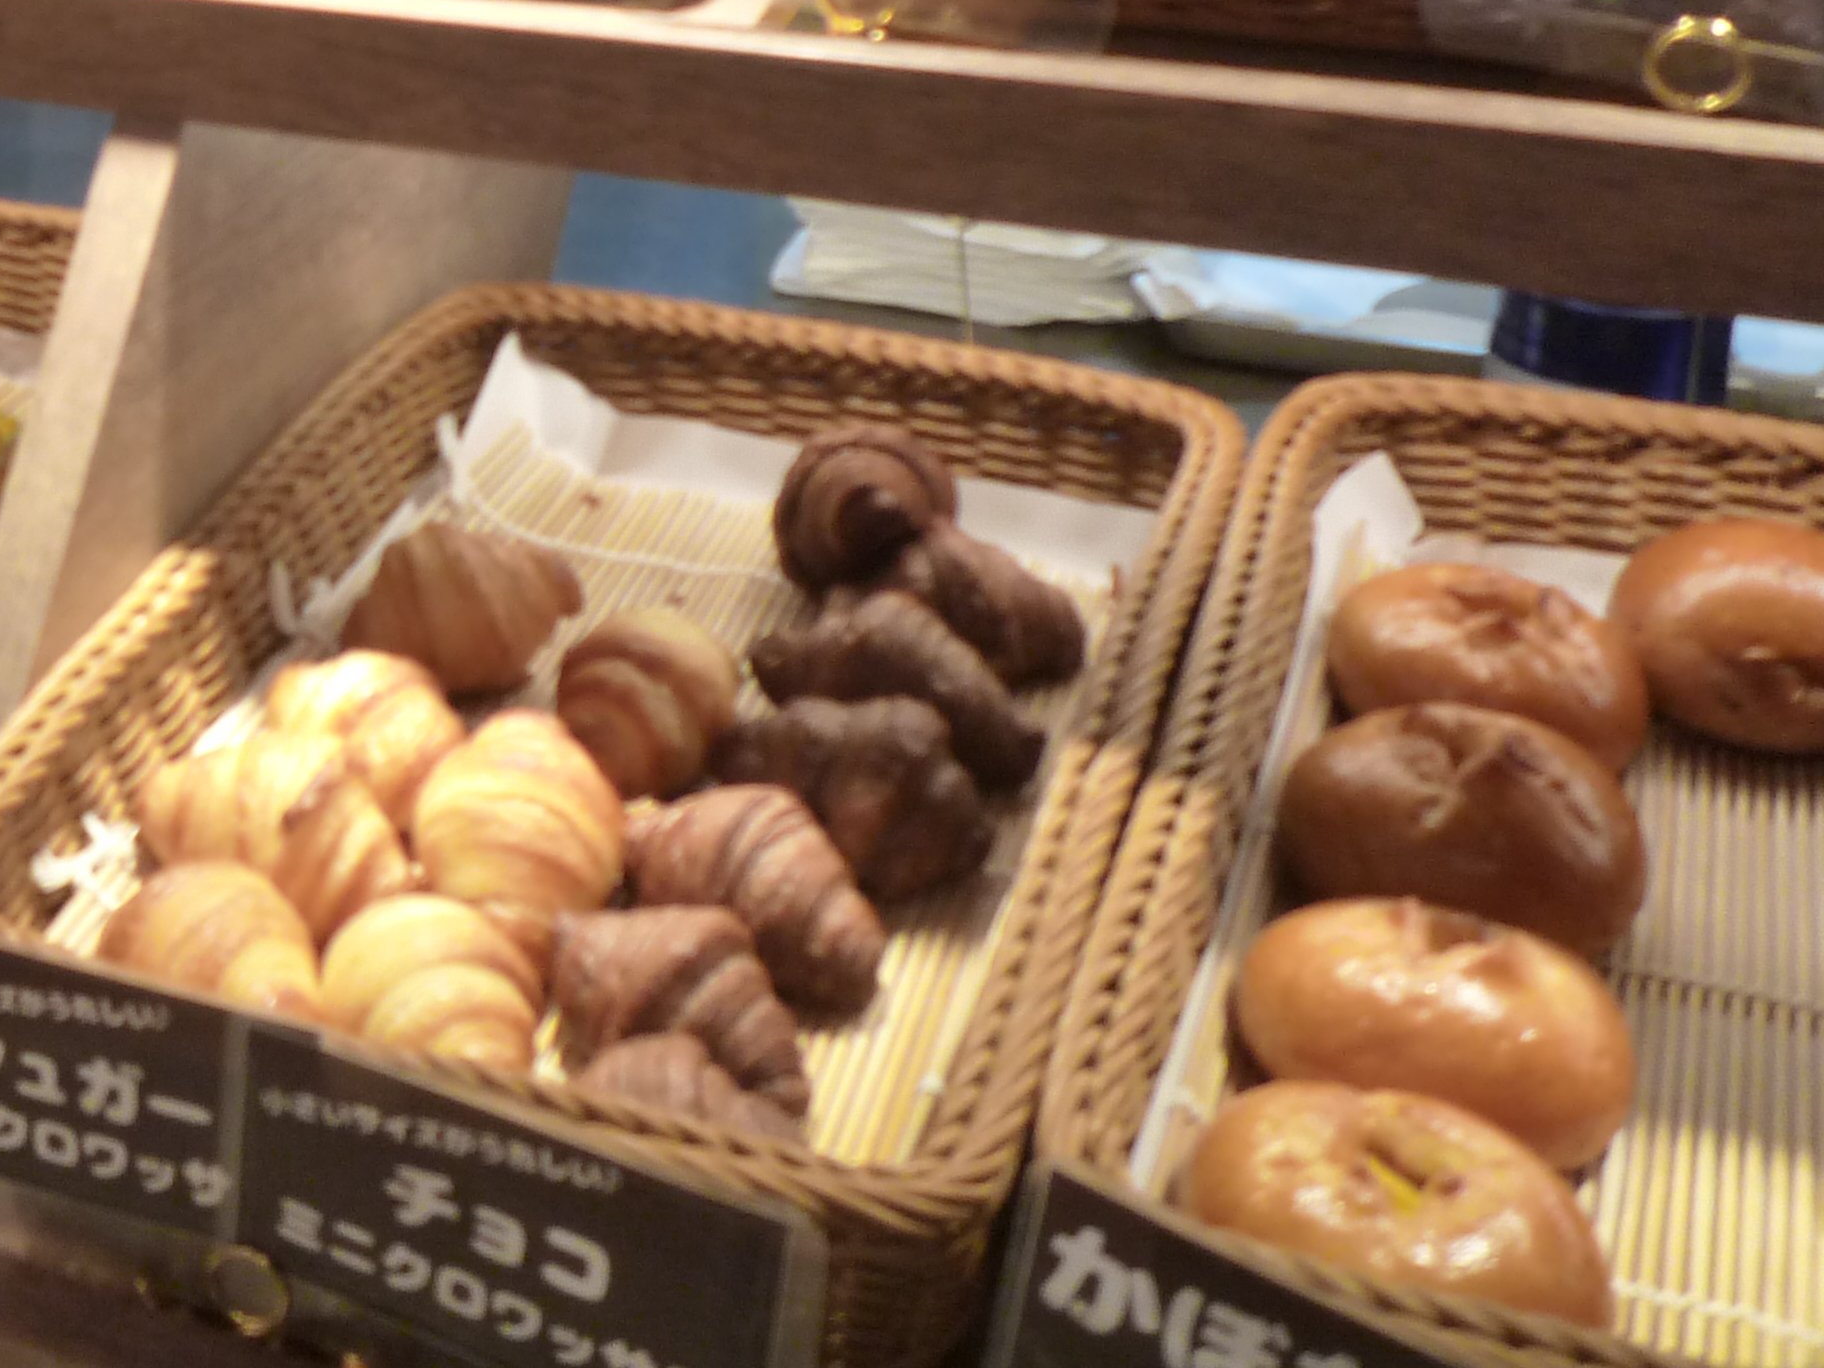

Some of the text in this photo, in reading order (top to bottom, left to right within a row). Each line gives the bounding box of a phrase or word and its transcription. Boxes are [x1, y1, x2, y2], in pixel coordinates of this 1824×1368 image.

[277, 1195, 681, 1368] ミニクロワッサ
[384, 1163, 611, 1303] チョコ
[1038, 1225, 1361, 1368] かぼ
